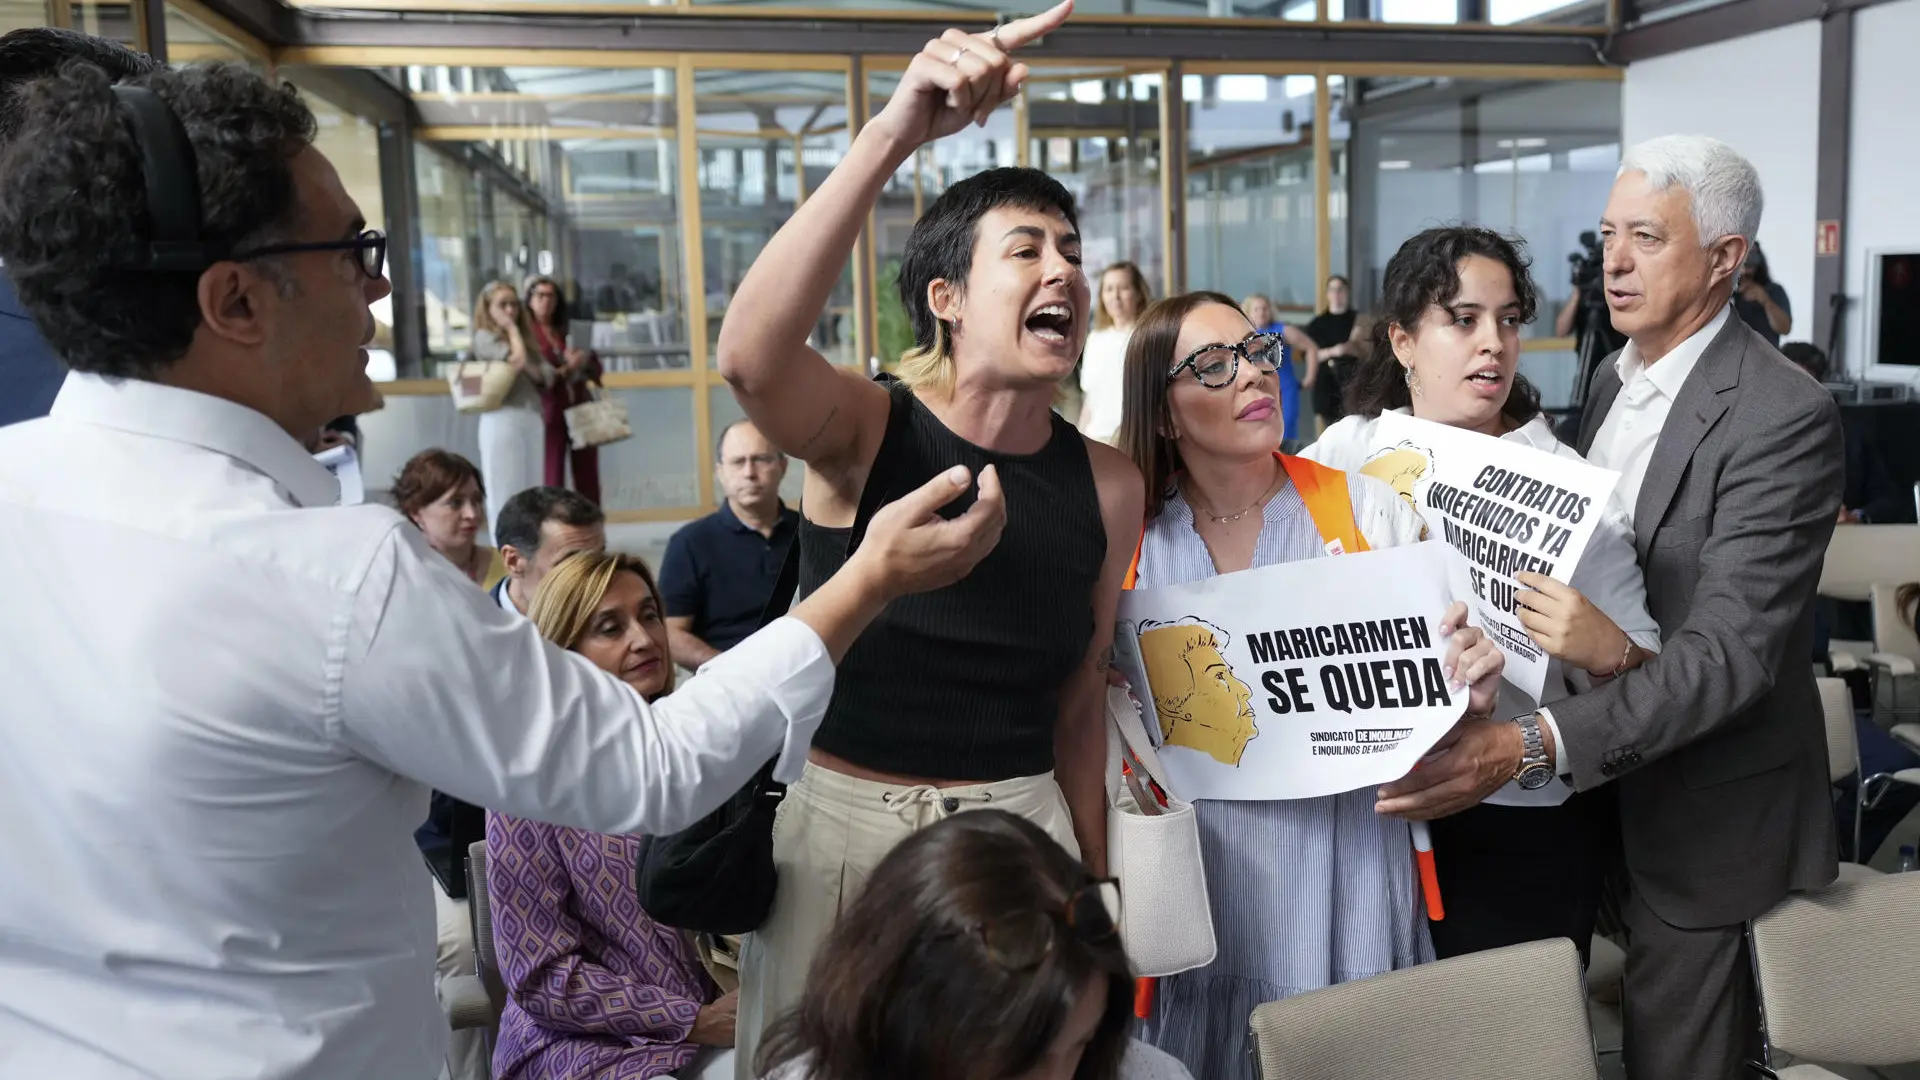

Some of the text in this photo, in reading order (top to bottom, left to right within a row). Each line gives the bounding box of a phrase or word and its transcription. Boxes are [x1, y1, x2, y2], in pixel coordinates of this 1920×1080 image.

[1473, 465, 1591, 524] CONTRATOS
[1427, 481, 1572, 557] INDEFINIDOS YA
[1470, 566, 1486, 600] SE
[1247, 616, 1431, 664] MARICARMEN
[1505, 639, 1513, 651] DE
[1514, 644, 1536, 663] MADRID
[1261, 658, 1452, 714] SE QUEDA
[1310, 731, 1354, 742] SINDICATO
[1356, 731, 1369, 742] DE
[1312, 746, 1318, 755] E
[1318, 745, 1361, 756] INQUILINOS
[1362, 745, 1371, 755] DE
